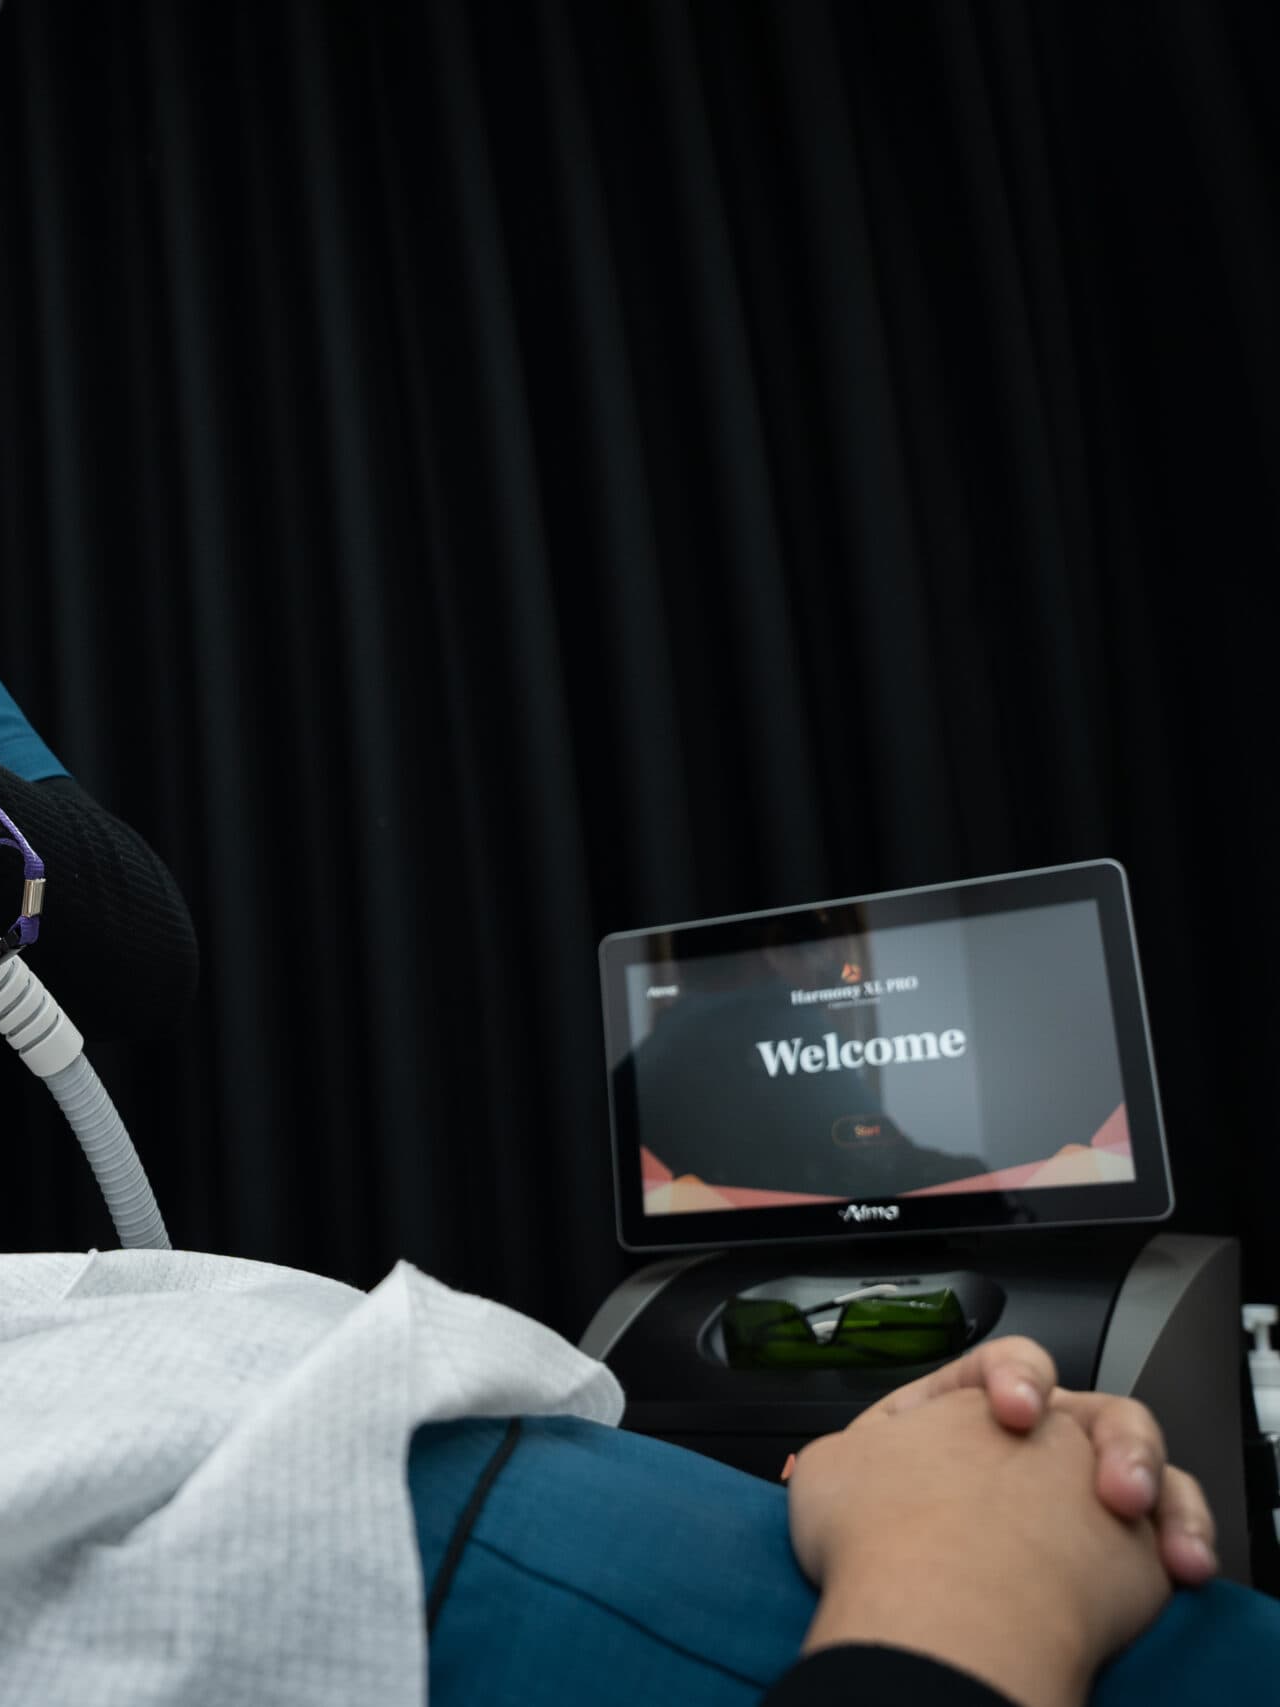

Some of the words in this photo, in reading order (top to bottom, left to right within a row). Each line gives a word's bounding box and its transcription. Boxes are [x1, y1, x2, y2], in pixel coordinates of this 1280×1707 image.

[790, 986, 861, 1005] Harmony
[886, 976, 919, 993] PRO
[756, 1027, 967, 1078] Welcome
[839, 1204, 899, 1222] Alma
